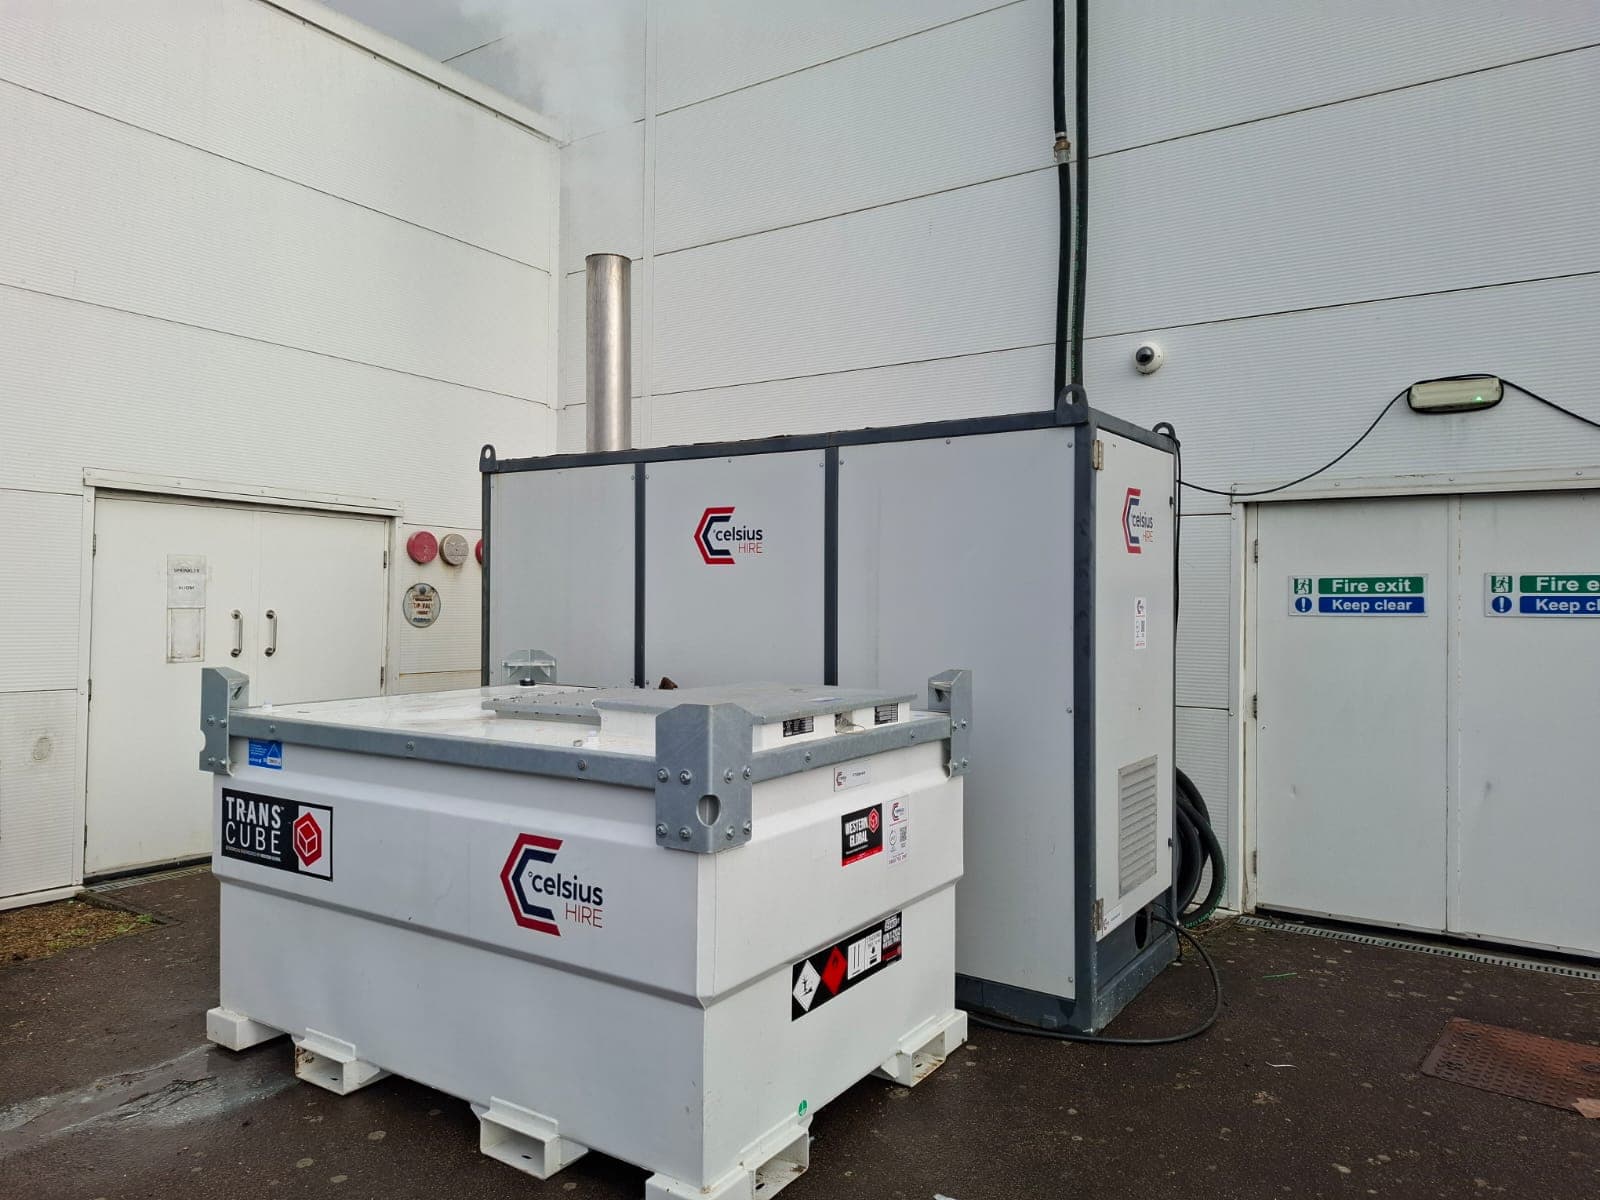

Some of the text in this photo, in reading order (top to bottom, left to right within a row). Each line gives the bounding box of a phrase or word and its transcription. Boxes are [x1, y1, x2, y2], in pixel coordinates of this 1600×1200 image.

[738, 542, 763, 554] HIRE
[1332, 579, 1411, 593] Fire exit
[1536, 576, 1579, 591] Fire
[1332, 599, 1412, 613] Keep clear
[1535, 598, 1580, 614] Keep
[225, 821, 282, 855] CUBE
[565, 902, 603, 929] HIRE
